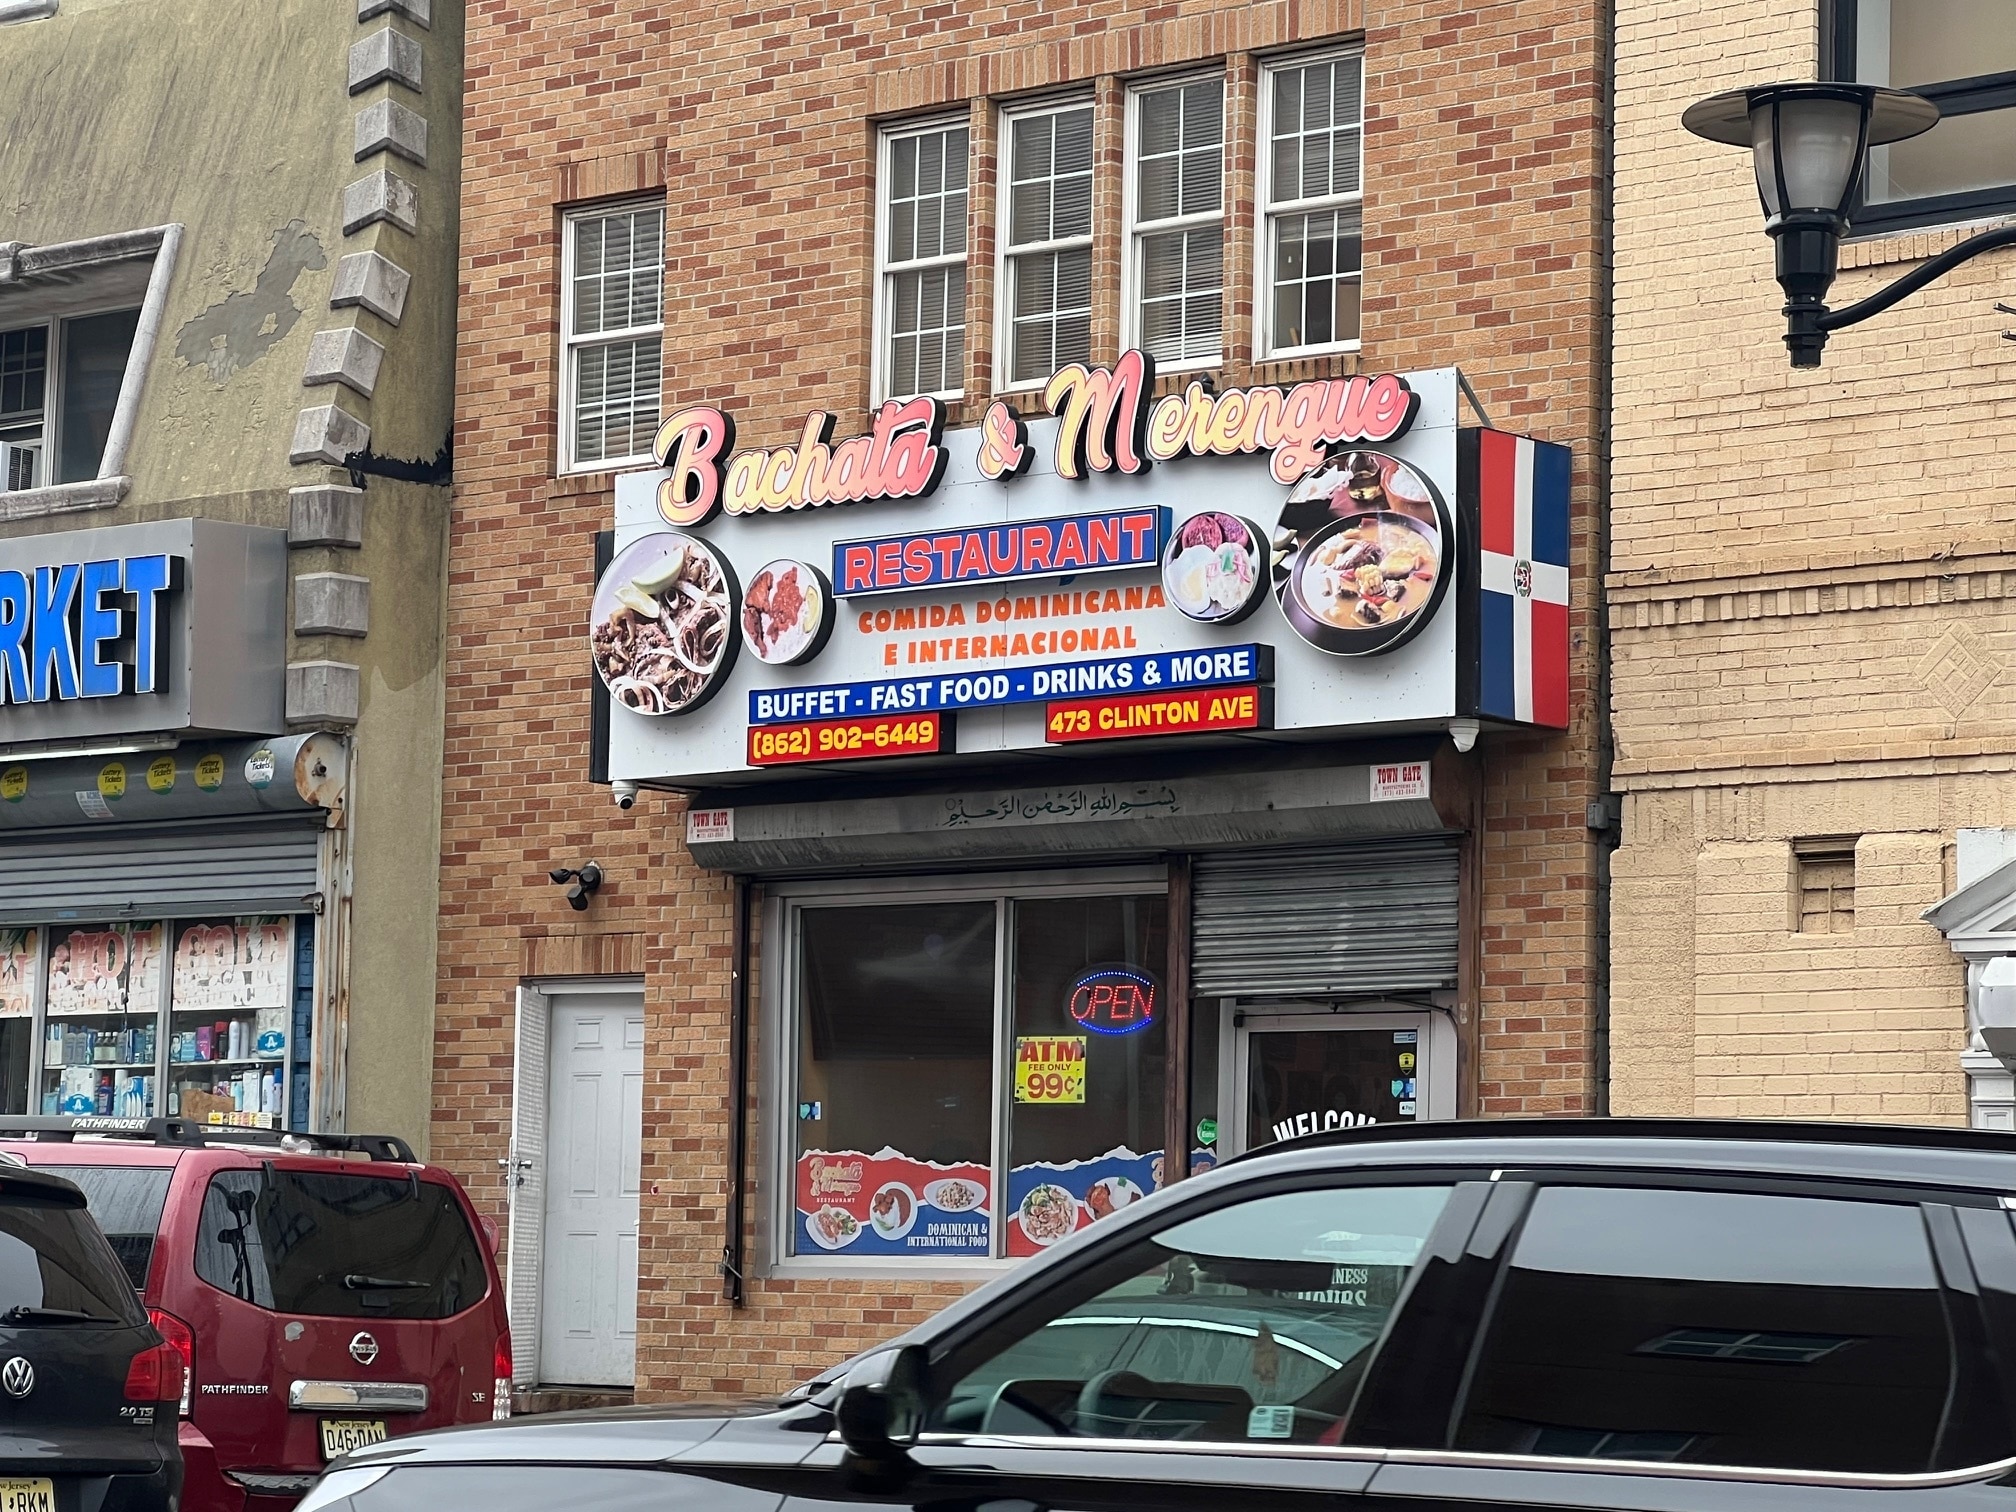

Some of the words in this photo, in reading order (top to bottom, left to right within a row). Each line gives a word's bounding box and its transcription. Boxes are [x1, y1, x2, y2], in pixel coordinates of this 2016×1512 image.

[653, 397, 938, 526] Bachata
[976, 401, 1023, 480] &
[1044, 349, 1412, 485] Merengue
[845, 514, 1153, 590] RESTAURANT
[858, 603, 966, 634] COMIDA
[976, 585, 1166, 624] DOMINICANA
[0, 553, 171, 705] RKET
[884, 643, 898, 666] E
[907, 626, 1137, 663] INTERNACIONAL
[757, 689, 850, 719] BUFFET
[870, 682, 933, 710] FAST
[940, 675, 1010, 704] FOOD
[1033, 662, 1134, 696] DRINKS
[1142, 660, 1162, 685] &
[1171, 651, 1250, 682] MORE
[1050, 710, 1091, 733] 473
[1099, 700, 1199, 730] CLINTON
[1208, 695, 1254, 721] AVE
[753, 728, 811, 759] (862)
[819, 720, 934, 751] 902-6449
[1377, 768, 1398, 784] TOWN
[1403, 765, 1422, 781] GATE
[68, 931, 152, 979] HOT
[180, 924, 288, 970] COLD
[1070, 984, 1156, 1019] OPEN
[1020, 1041, 1083, 1062] ATM
[1047, 1063, 1071, 1071] ONLY
[1027, 1073, 1075, 1099] 99¢
[71, 1118, 147, 1130] PATHFINDER
[907, 1236, 967, 1247] INTERNATIONAL
[969, 1236, 988, 1247] FOOD
[928, 1223, 979, 1236] DOMINICAN
[981, 1223, 988, 1234] &
[201, 1384, 269, 1394] PATHFINDER
[472, 1392, 486, 1403] SE
[336, 1420, 349, 1428] New
[349, 1420, 370, 1429] Jersey
[8, 1481, 31, 1491] Jersey
